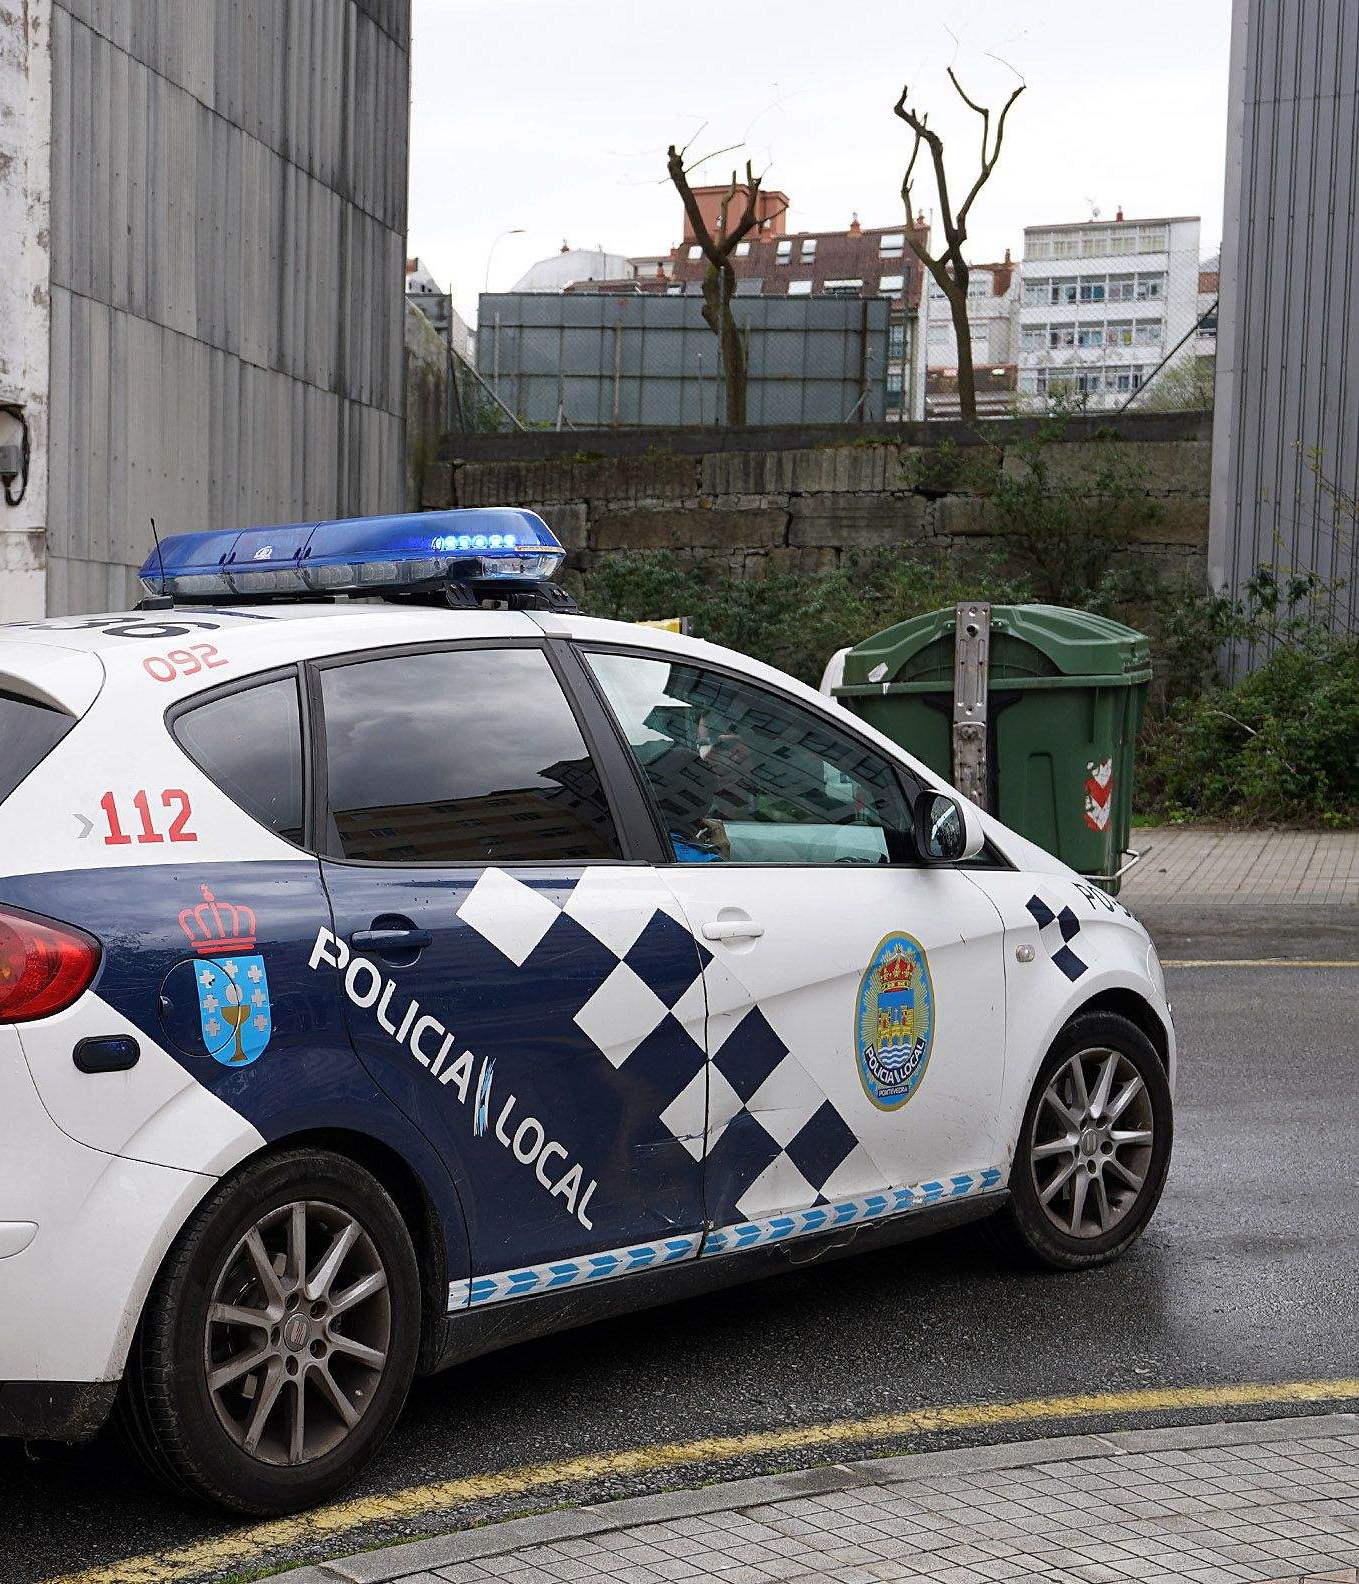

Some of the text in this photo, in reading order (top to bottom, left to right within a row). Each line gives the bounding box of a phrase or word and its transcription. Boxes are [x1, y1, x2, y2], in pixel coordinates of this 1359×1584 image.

[143, 643, 229, 682] 092
[100, 789, 198, 845] 112
[308, 926, 598, 1231] POLICIA LOCAL
[865, 1042, 925, 1084] POLICIA LOCAL
